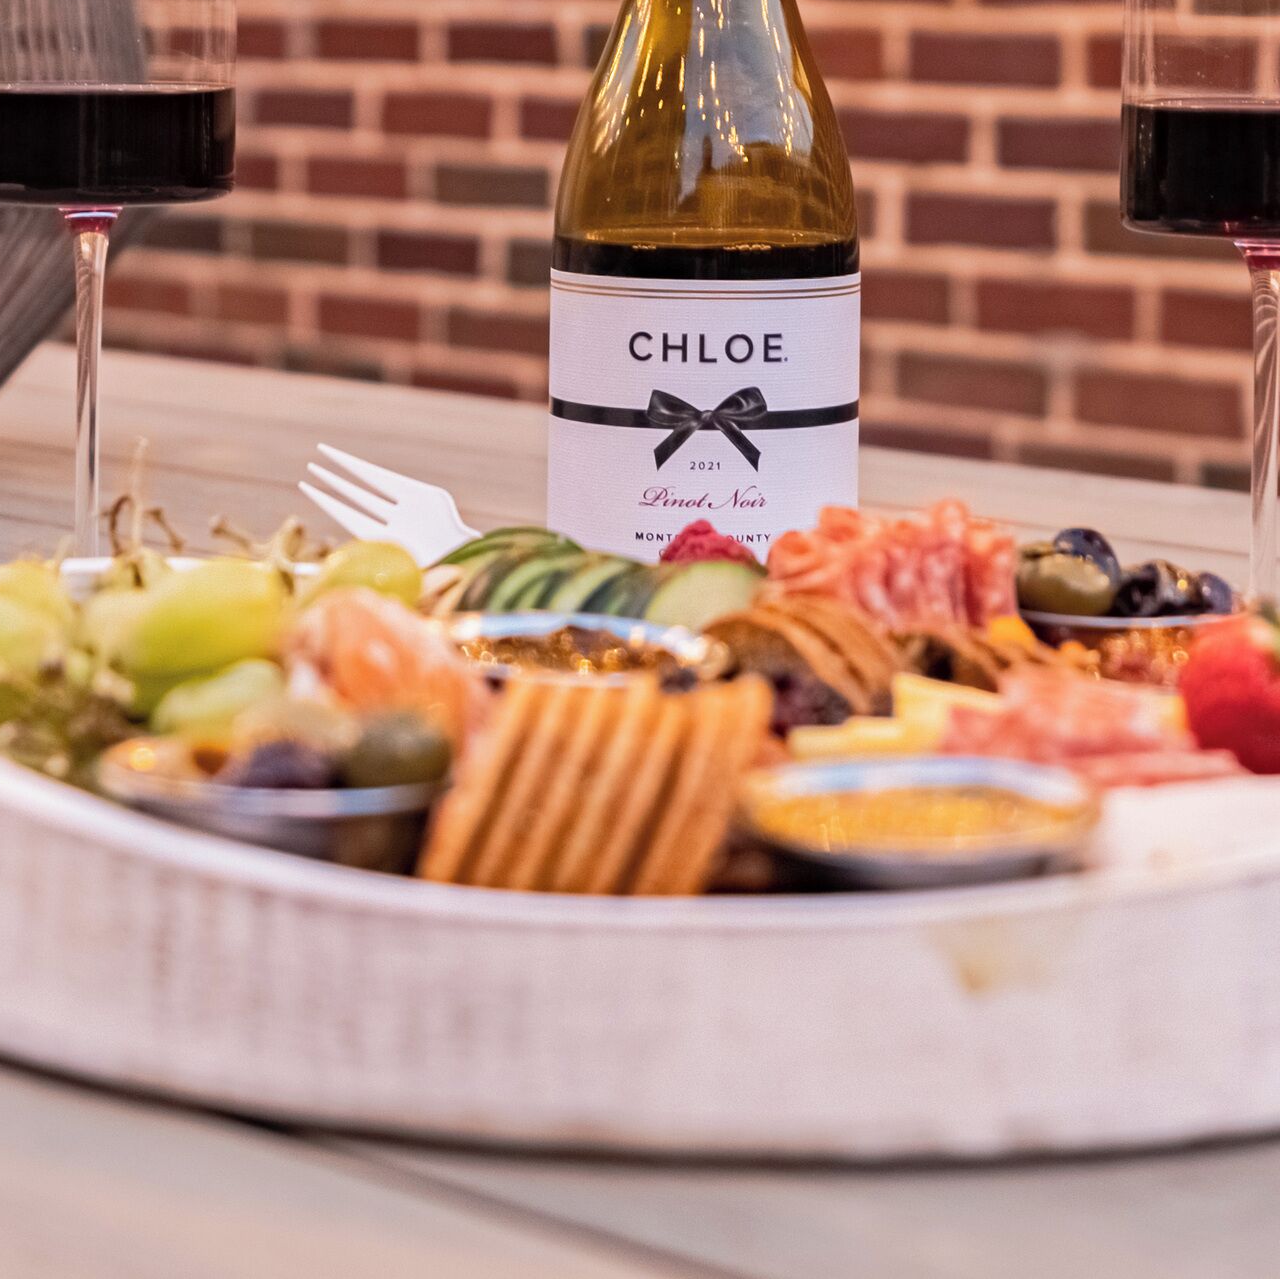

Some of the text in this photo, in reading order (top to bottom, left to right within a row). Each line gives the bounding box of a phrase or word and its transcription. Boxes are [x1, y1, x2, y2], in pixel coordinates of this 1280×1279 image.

[689, 461, 721, 471] 2021
[638, 485, 767, 509] Pinot Noir
[727, 533, 771, 544] OUNTY
